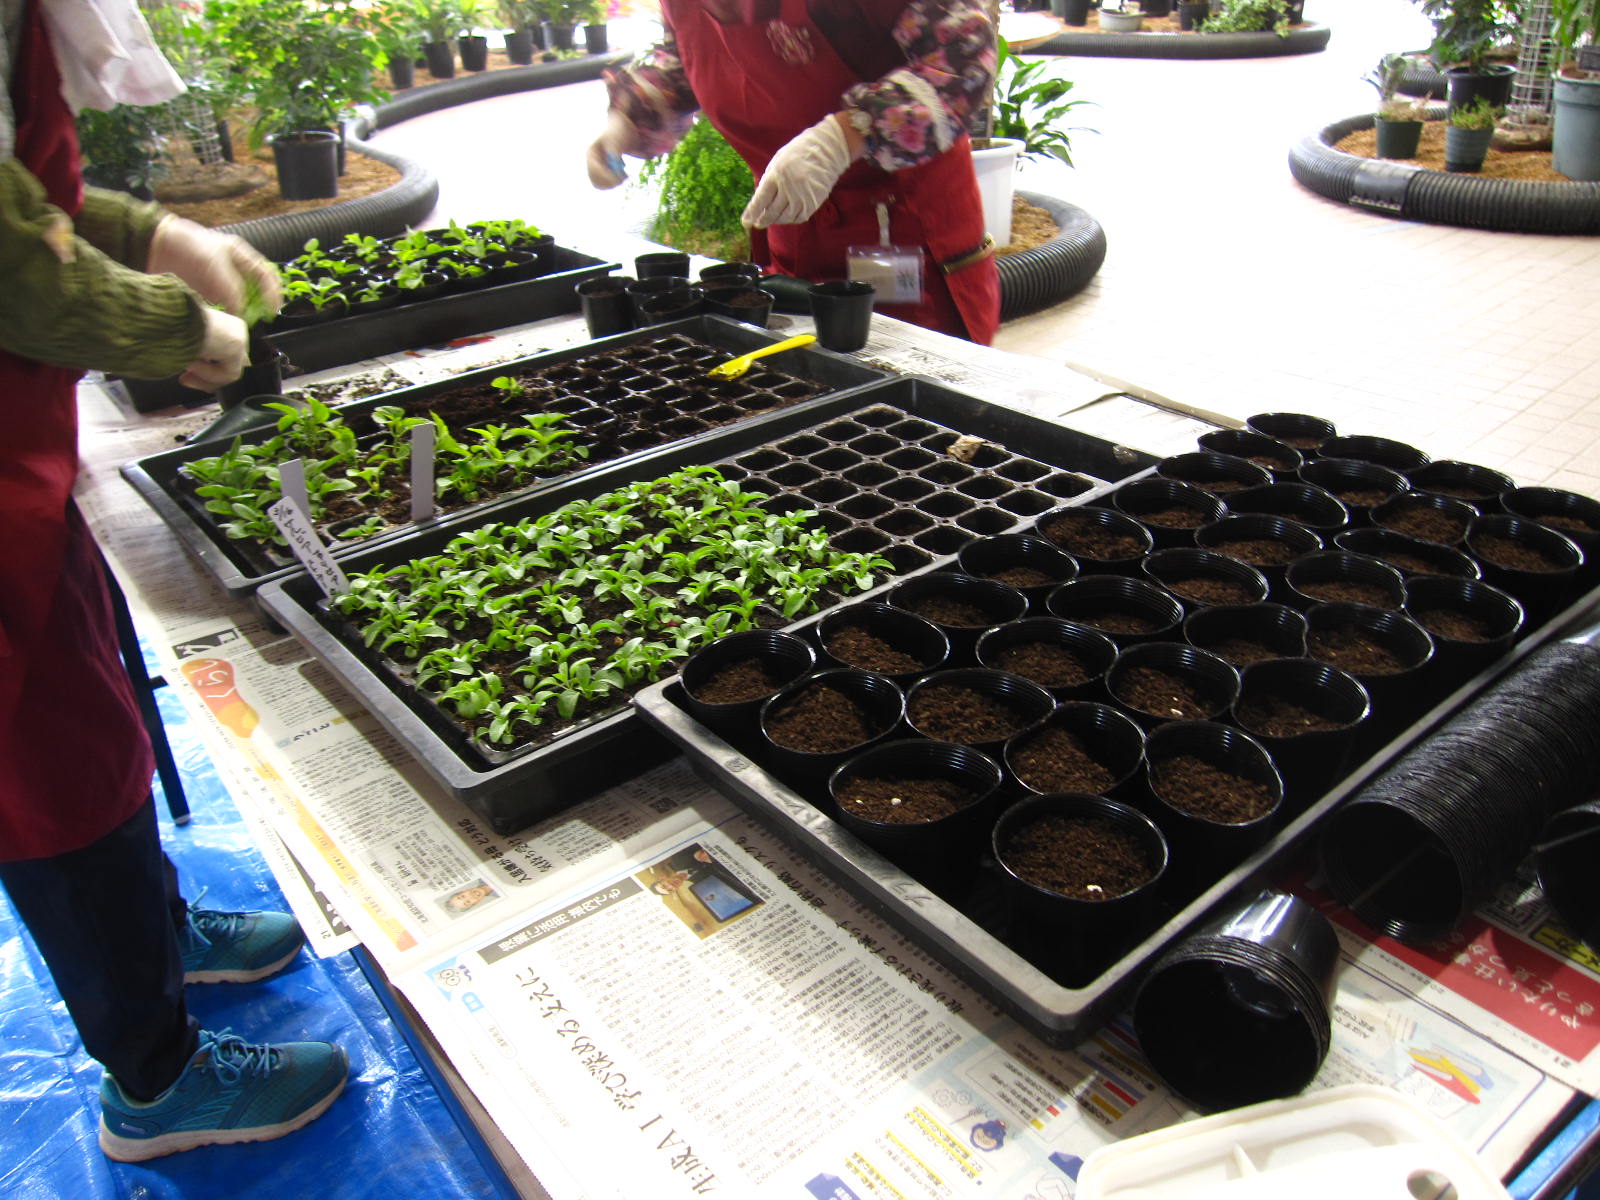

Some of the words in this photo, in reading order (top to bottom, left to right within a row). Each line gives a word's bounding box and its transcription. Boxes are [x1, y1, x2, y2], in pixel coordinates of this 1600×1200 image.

[189, 660, 236, 698] くらし
[458, 818, 490, 846] どう対応
[498, 913, 570, 952] 授業に活用
[567, 887, 621, 919] 道内でも
[835, 919, 964, 1015] 取り残される子減らす
[515, 966, 642, 1110] 学び深める支えに
[1554, 1055, 1572, 1068] 21
[639, 1114, 717, 1194] 生成AI
